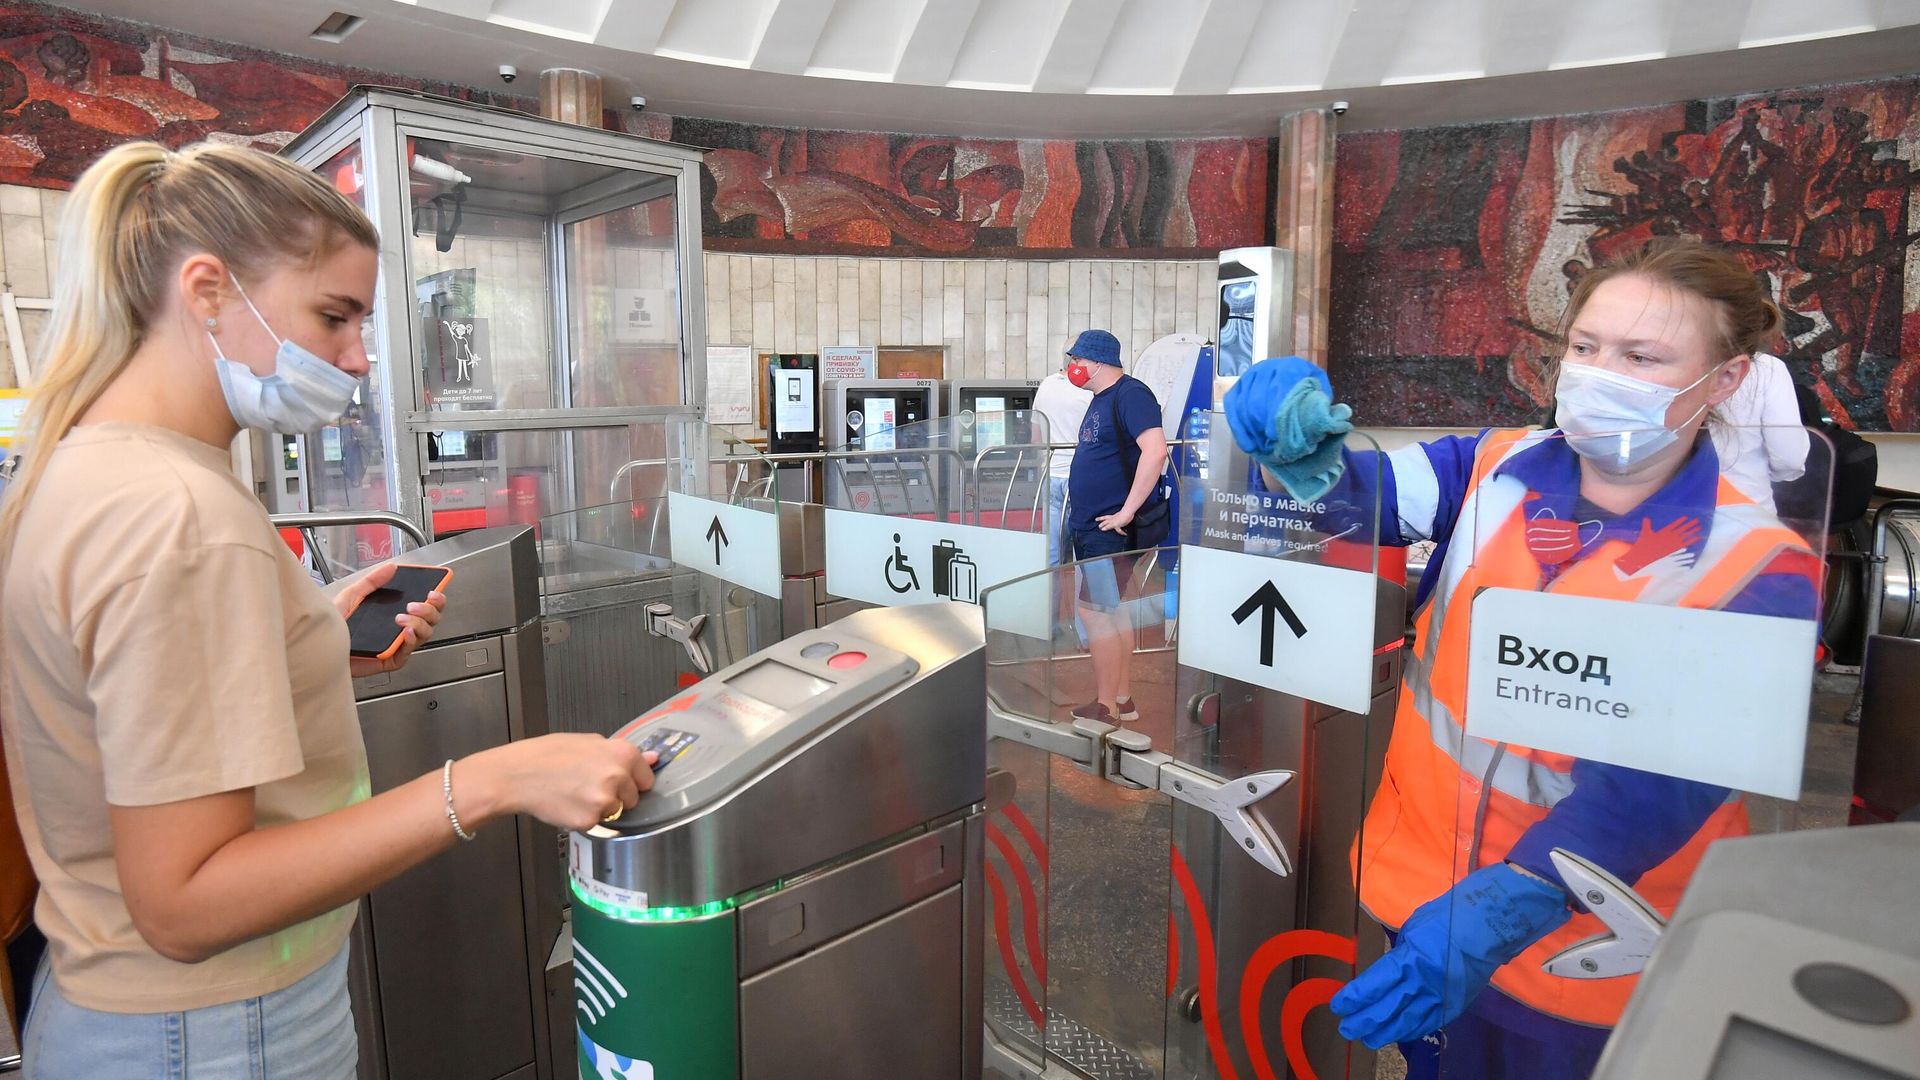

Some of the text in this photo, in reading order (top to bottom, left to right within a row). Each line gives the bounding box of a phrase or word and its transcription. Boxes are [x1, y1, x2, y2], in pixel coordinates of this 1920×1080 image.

[1209, 488, 1327, 514] Только в маске
[1219, 510, 1228, 521] и
[1205, 527, 1329, 553] Mask and gloves required
[1498, 634, 1611, 686] Вход
[1496, 677, 1630, 718] Entrance
